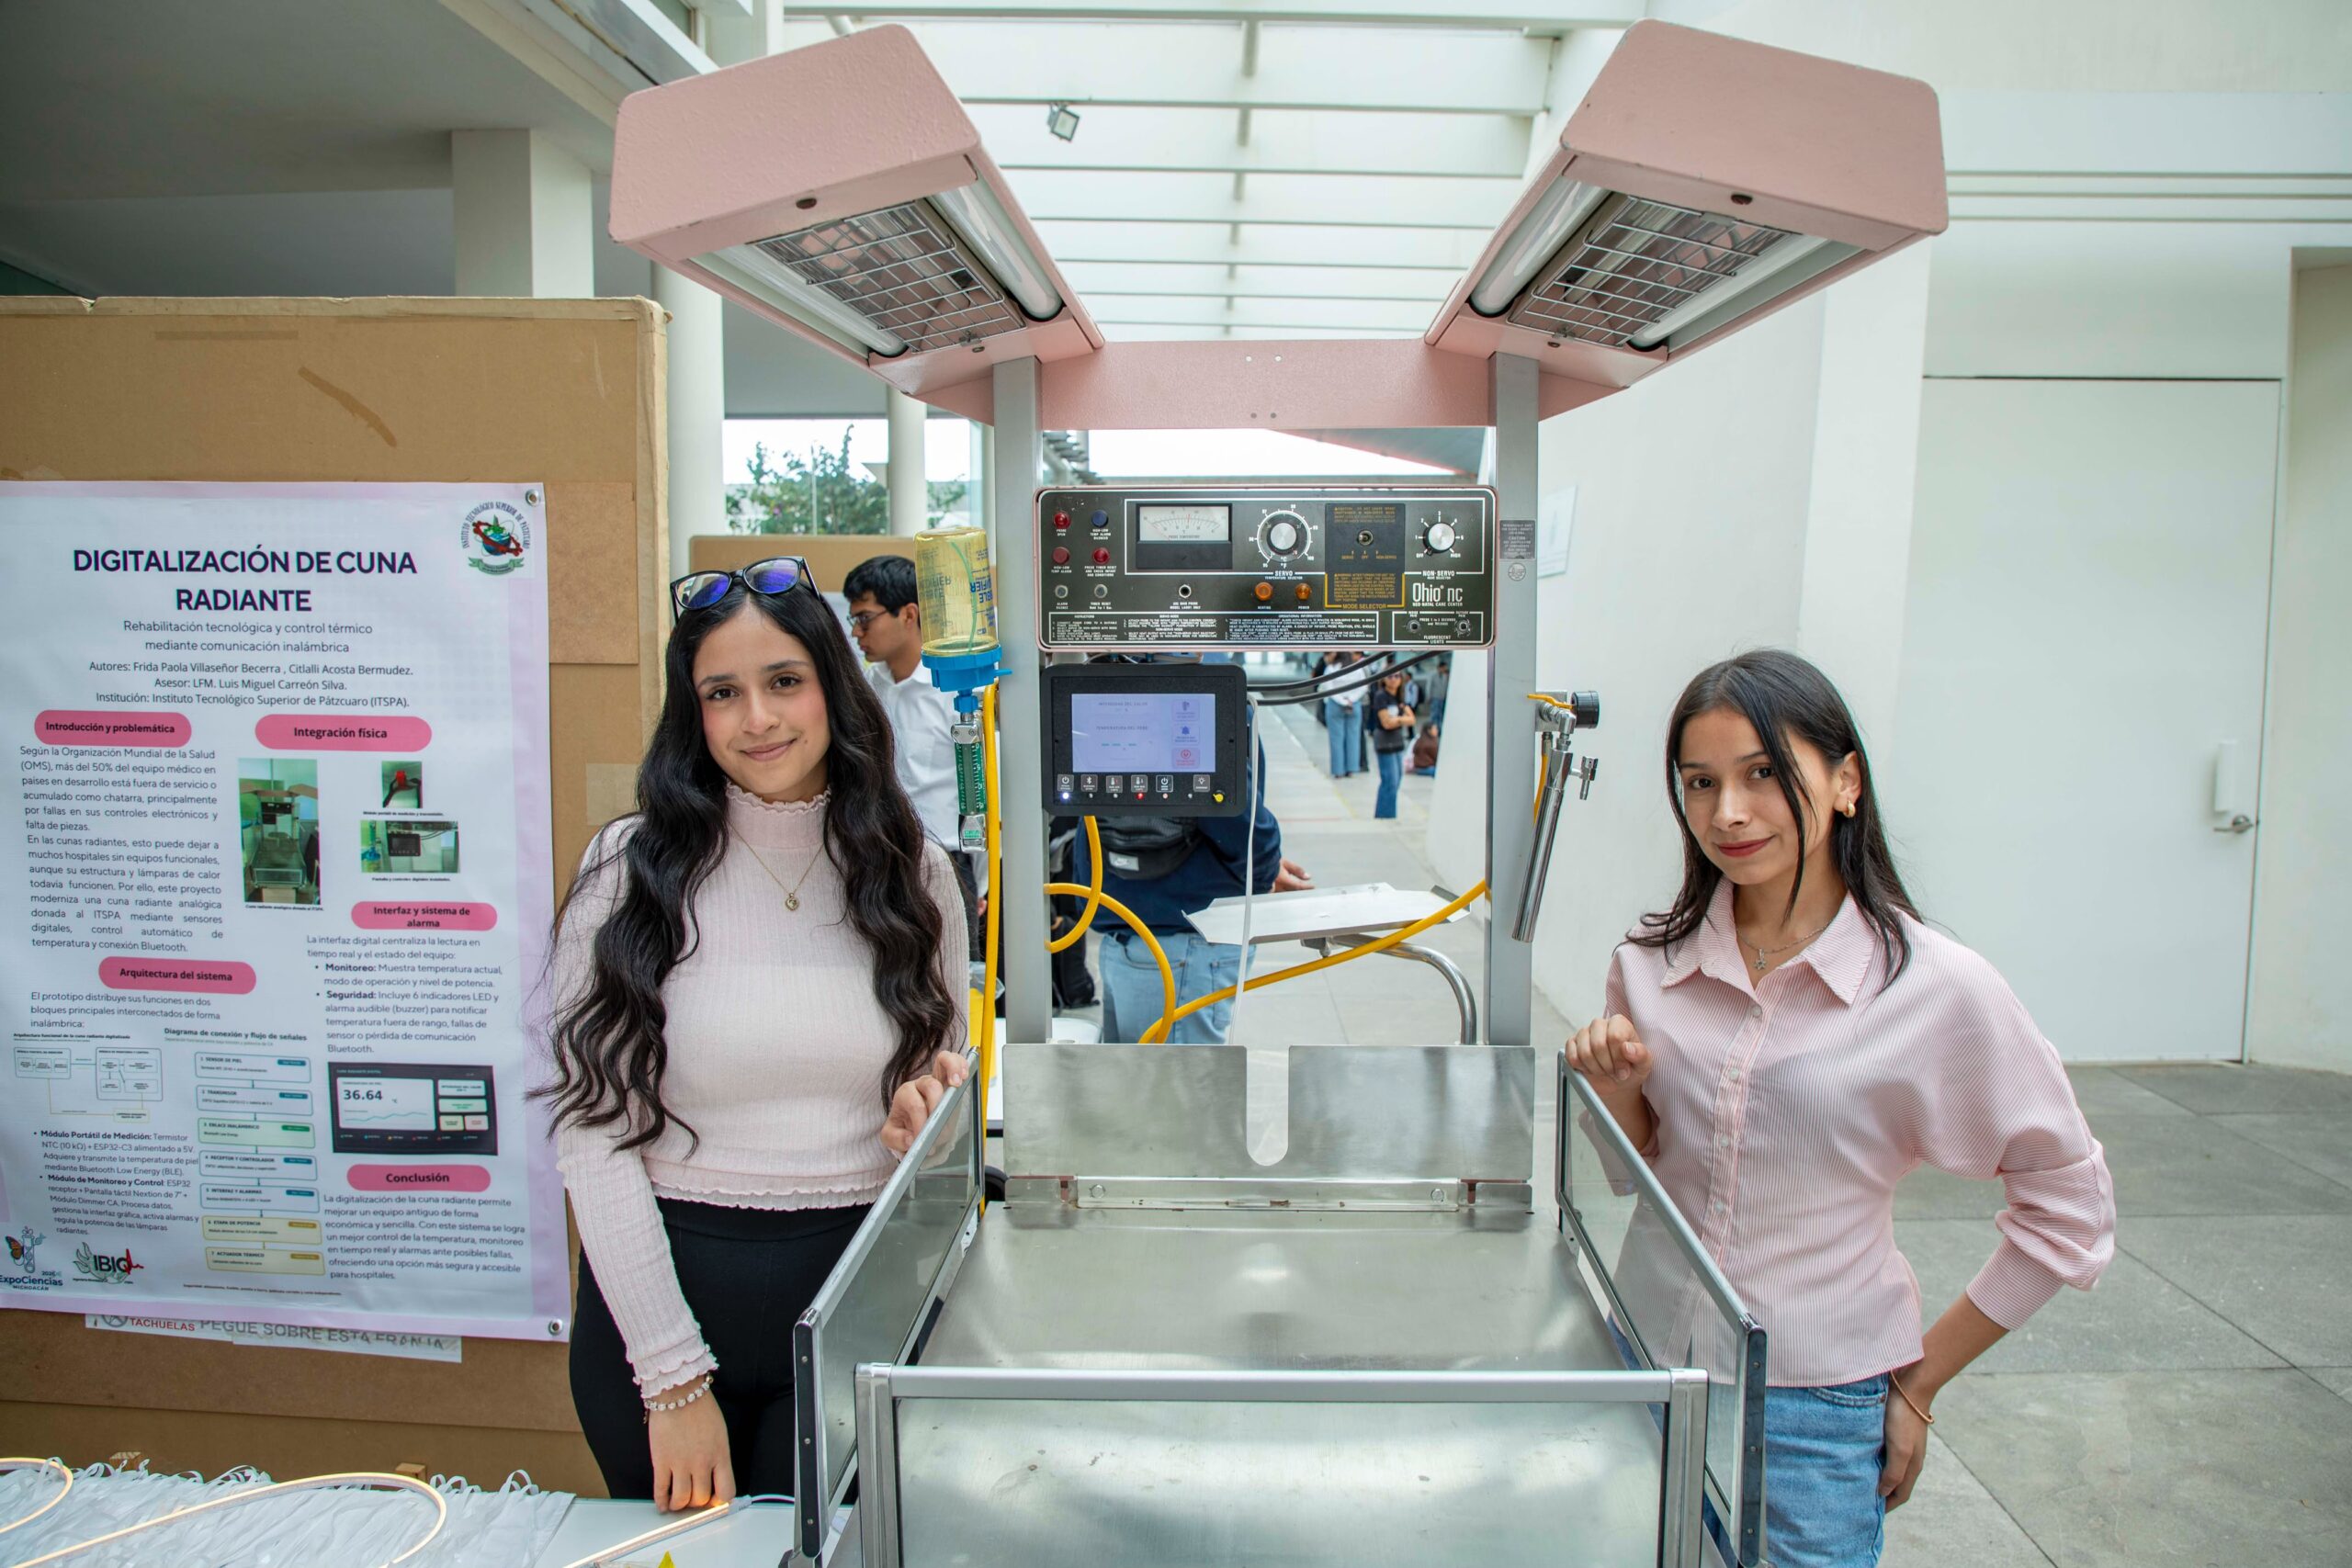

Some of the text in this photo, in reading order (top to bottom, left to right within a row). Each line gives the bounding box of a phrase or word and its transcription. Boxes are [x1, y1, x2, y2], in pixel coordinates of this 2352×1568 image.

[74, 544, 417, 573] DIGITALIZACIÓN DE CUNA
[176, 589, 311, 611] RADIANTE
[1447, 588, 1463, 602] nc
[123, 620, 372, 636] Rehabilitación tecnológica y control térmico
[145, 639, 349, 652] mediante comunicación inalámbrica
[88, 661, 413, 675] Autores: Frida Paola Villaseñor Becerra Citlalli Acosta Bermudez.
[154, 678, 189, 687] Asesor:
[219, 679, 239, 688] Luis
[241, 679, 275, 691] Miguel
[277, 680, 319, 689] Carreón
[322, 680, 346, 690] Silva.
[96, 693, 409, 707] Institución: Instituto Tecnológico Superior de Pátzcuaro (ITSPA).
[46, 722, 175, 734] Introducción y problemática
[294, 728, 387, 739] Integración física
[19, 746, 215, 759] Según la Organización Mundial de la Salud
[55, 762, 74, 771] más
[75, 762, 89, 771] del
[92, 762, 113, 772] 50%
[115, 763, 130, 772] del
[131, 765, 164, 774] equipo
[166, 764, 201, 773] médico
[64, 777, 109, 786] desarrollo
[111, 779, 130, 787] está
[132, 778, 156, 787] fuera
[159, 779, 171, 788] de
[373, 906, 469, 917] Interfaz y sistema de
[406, 919, 440, 927] alarma
[306, 935, 316, 943] La
[318, 936, 350, 944] interfaz
[352, 937, 380, 946] digital
[428, 936, 435, 945] la
[437, 937, 467, 946] lectura
[119, 968, 232, 981] Arquitectura del sistema
[30, 991, 40, 999] El
[41, 993, 84, 1001] prototipo
[85, 993, 126, 1003] distribuye
[142, 995, 182, 1004] funciones
[379, 991, 410, 1000] Incluye
[473, 992, 492, 1001] LED
[164, 1027, 198, 1035] Diagrama
[344, 1089, 382, 1100] 36.64
[385, 1173, 449, 1182] Conclusión
[323, 1194, 333, 1202] La
[335, 1195, 392, 1204] digitalización
[130, 1317, 195, 1331] TACHUELAS
[200, 1320, 257, 1335] PEGUE
[263, 1323, 322, 1340] SOBRE
